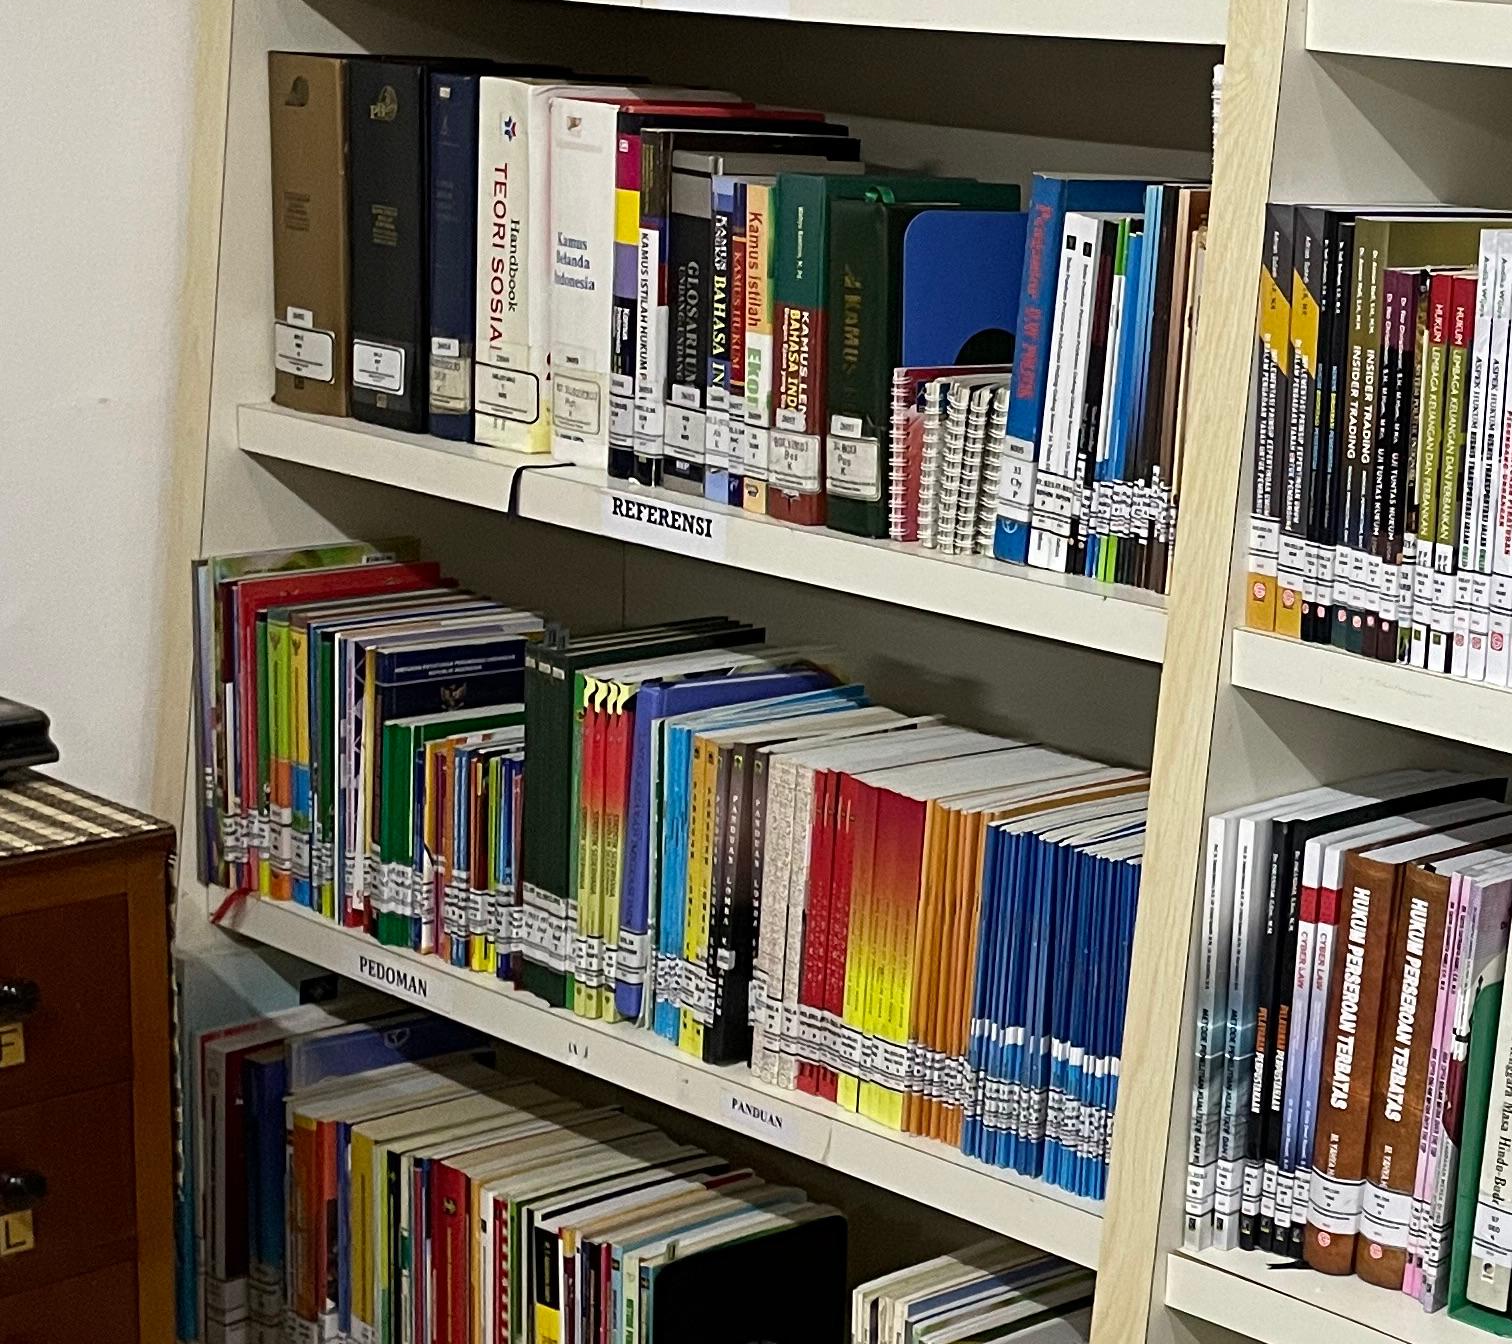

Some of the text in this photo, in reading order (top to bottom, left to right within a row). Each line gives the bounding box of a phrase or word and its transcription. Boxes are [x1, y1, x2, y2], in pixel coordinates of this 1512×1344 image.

[491, 162, 507, 248] TEORI
[508, 218, 520, 312] Handbook
[557, 232, 588, 250] Kamus
[748, 212, 763, 269] Kamus
[640, 232, 649, 370] KAMUS ISTILAH HUKUM
[734, 251, 742, 304] KAMUS
[712, 276, 727, 355] BAHASA
[789, 310, 800, 372] BAHASA
[799, 311, 810, 377] KAMUS
[611, 496, 713, 538] REFERENSI
[359, 955, 428, 998] PEDOMAN
[1332, 887, 1370, 1110] HUKUM PERSEROAN TERBATAS
[1384, 898, 1428, 1122] HUKUM PERSEROAN TERBATAS
[731, 1106, 785, 1129] PANDUAN
[5, 1212, 28, 1248] L
